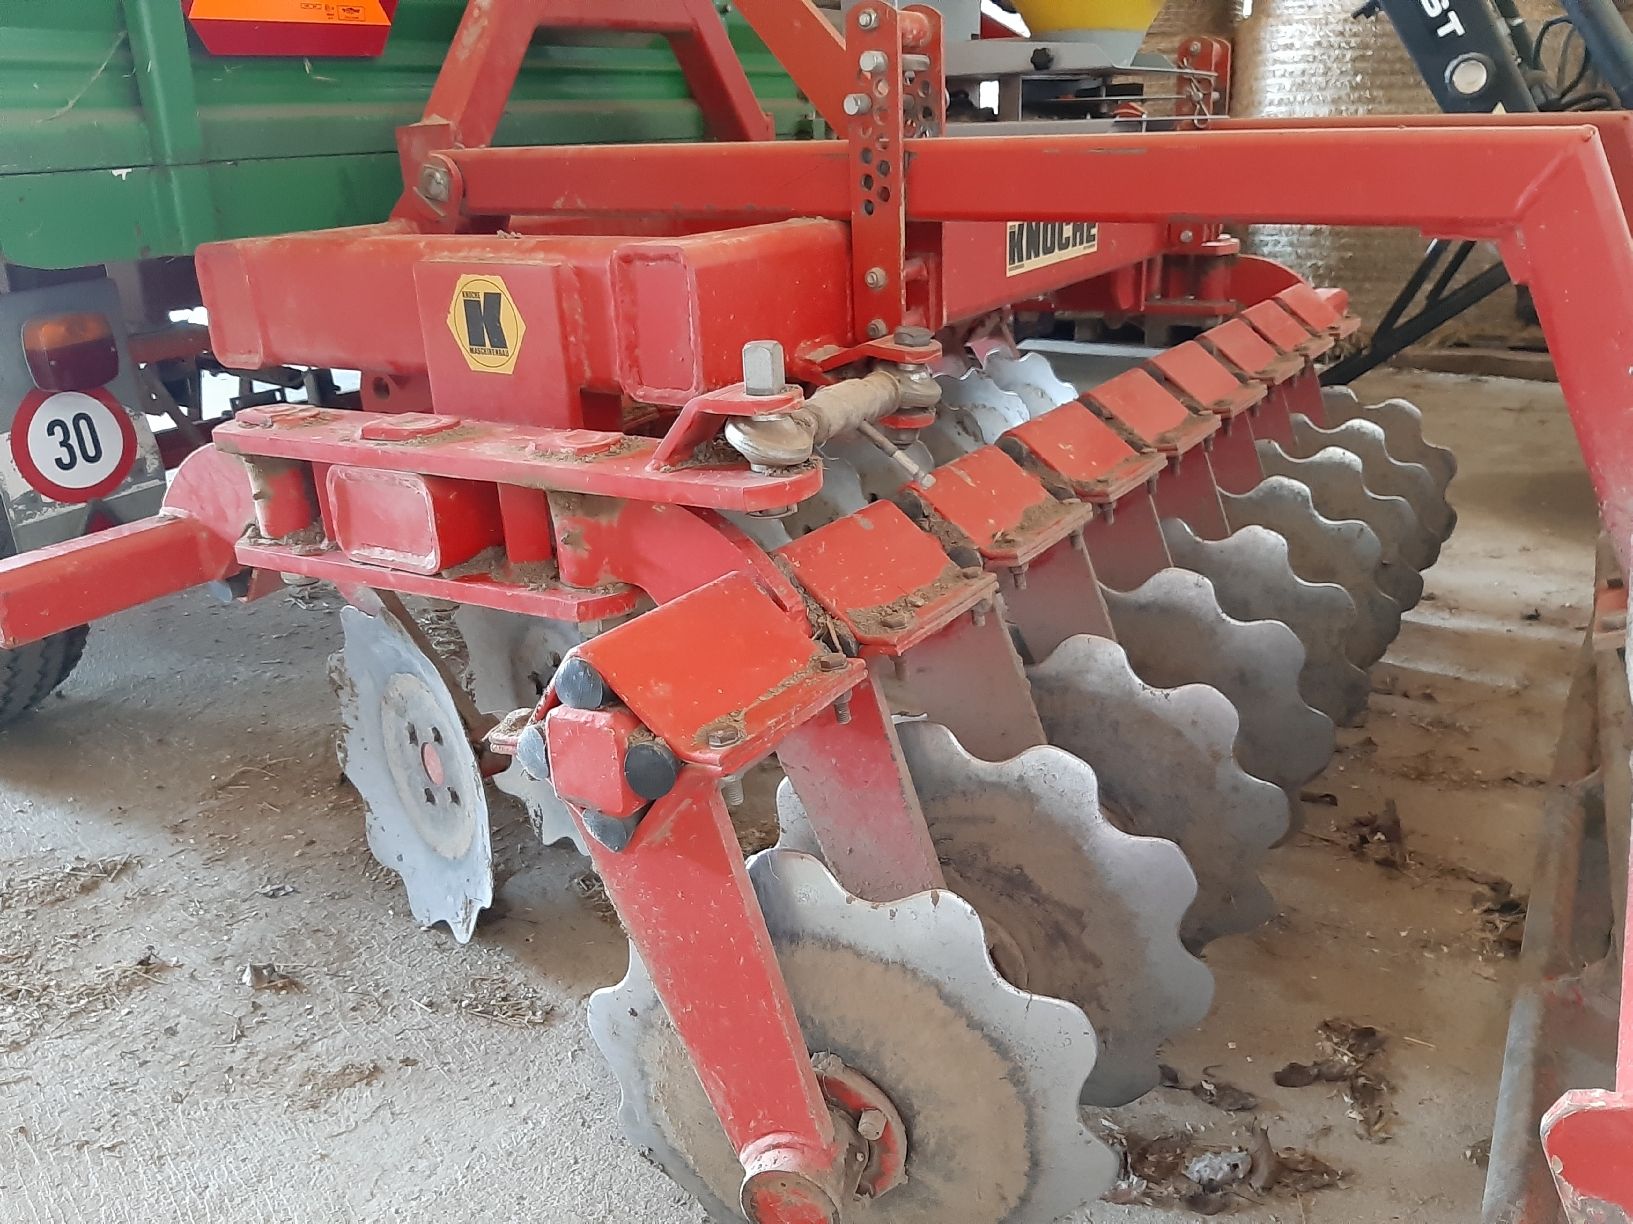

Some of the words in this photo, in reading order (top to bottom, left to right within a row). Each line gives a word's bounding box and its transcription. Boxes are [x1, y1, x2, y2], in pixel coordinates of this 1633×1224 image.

[1008, 222, 1097, 266] KNOCHE
[463, 292, 508, 349] K
[46, 412, 103, 471] 30
